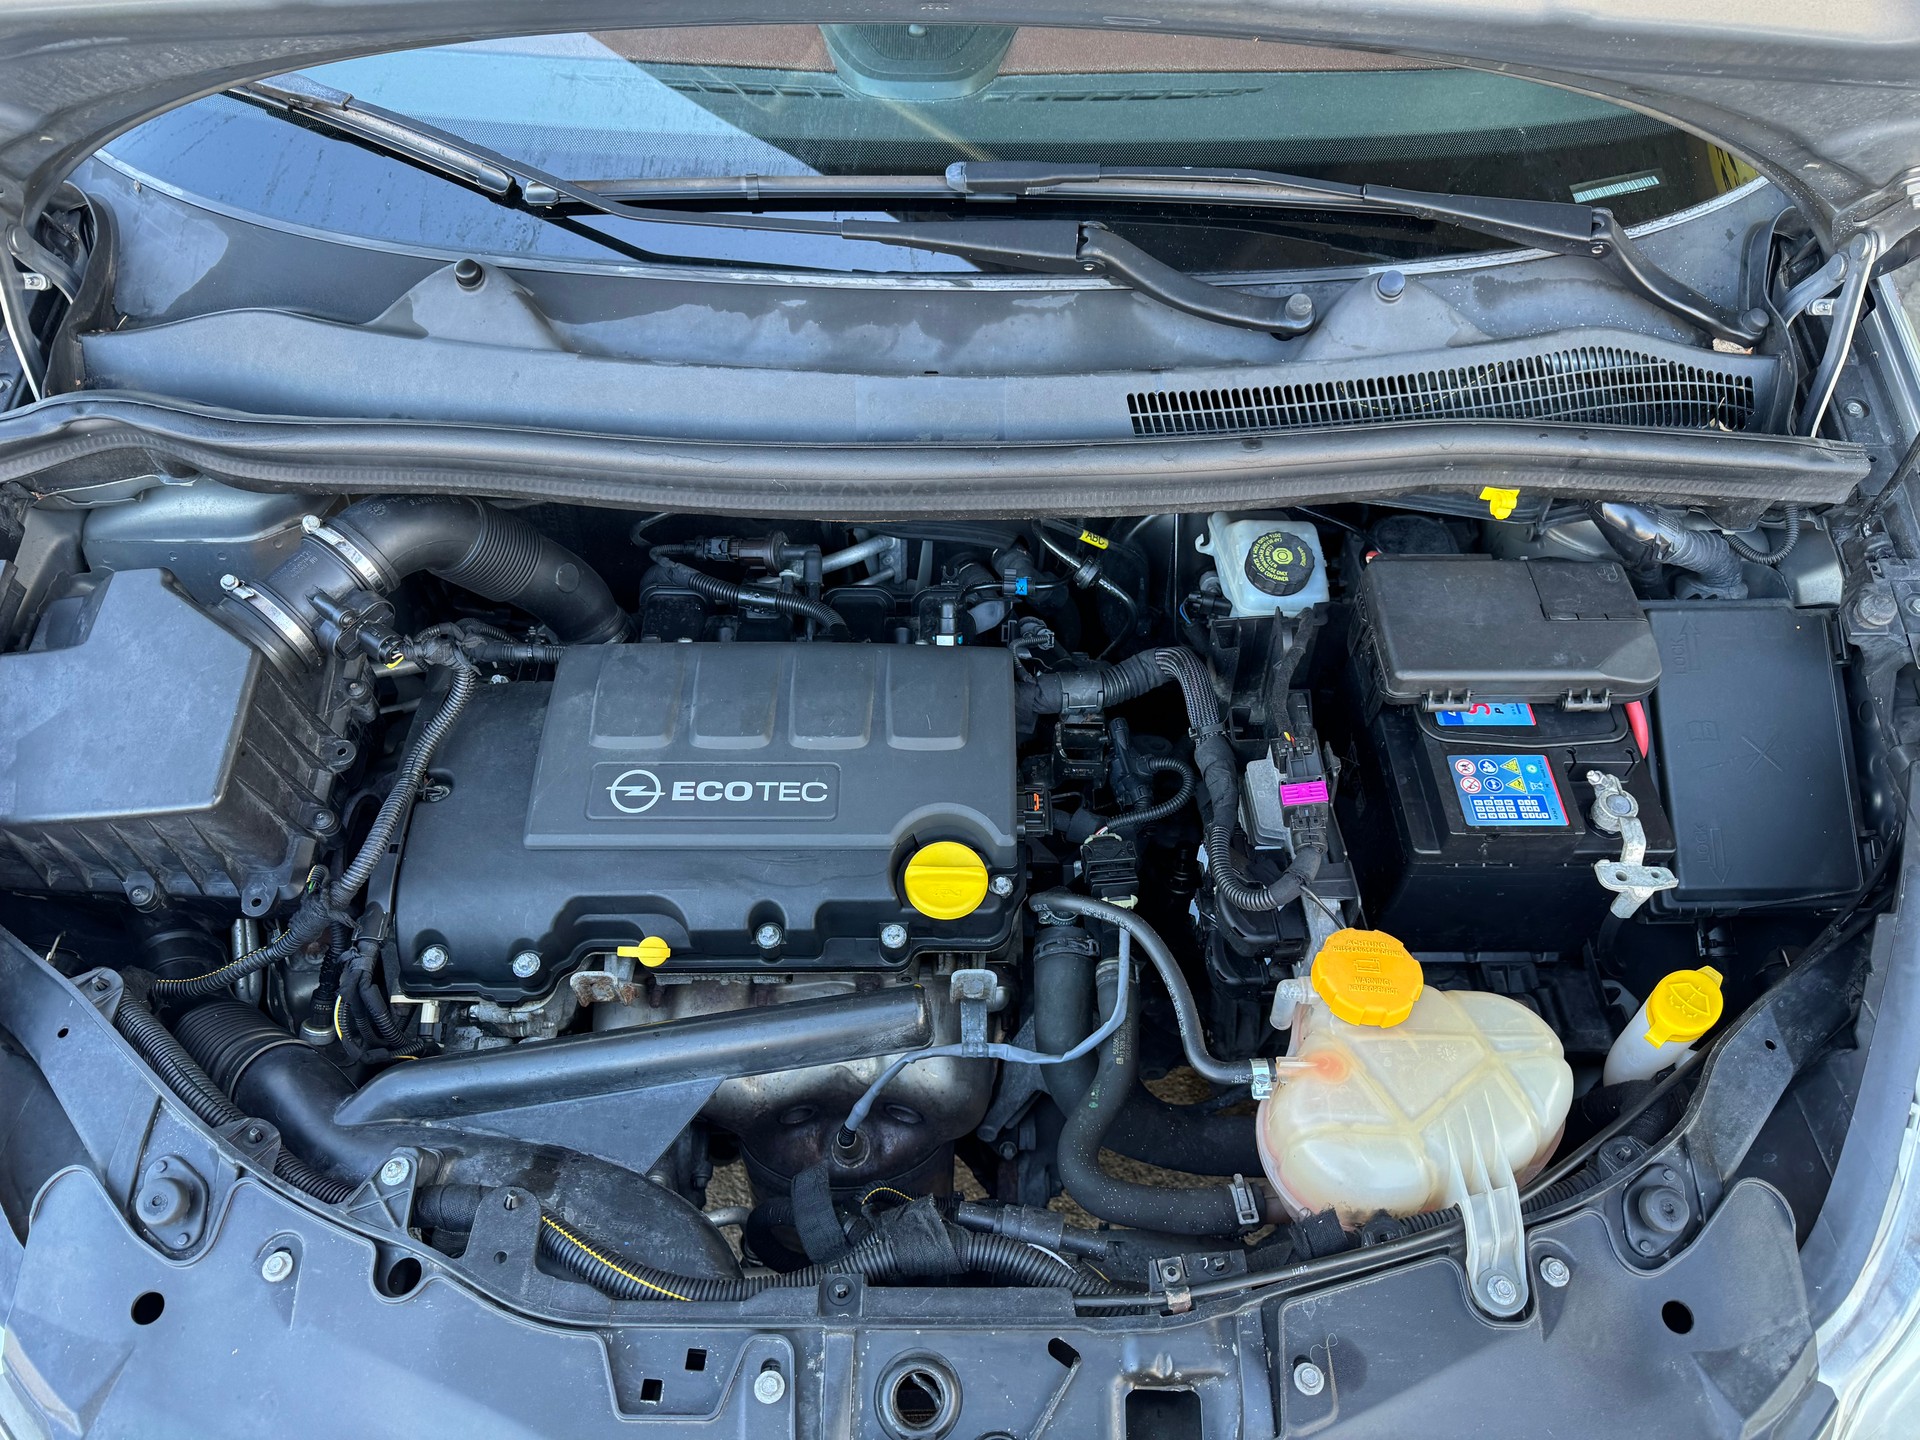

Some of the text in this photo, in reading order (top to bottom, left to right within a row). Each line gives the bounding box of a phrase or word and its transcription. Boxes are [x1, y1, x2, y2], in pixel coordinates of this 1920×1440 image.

[671, 781, 829, 802] ECOTEC
[1694, 824, 1711, 863] LOCK
[1369, 986, 1386, 994] OPEN
